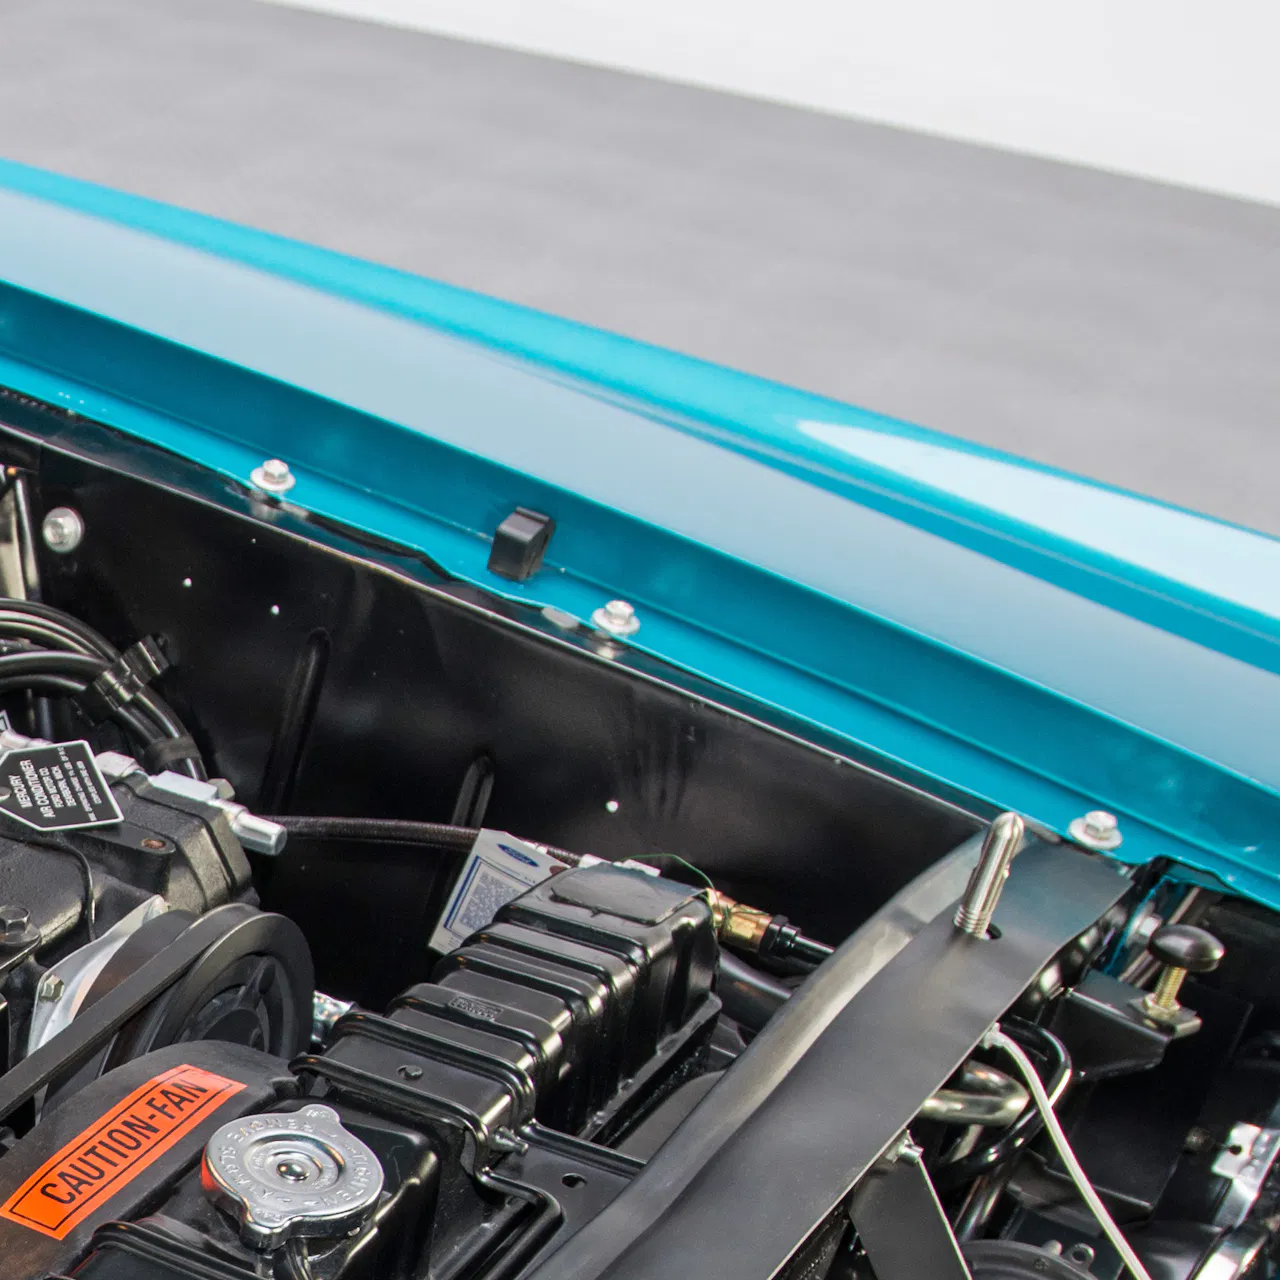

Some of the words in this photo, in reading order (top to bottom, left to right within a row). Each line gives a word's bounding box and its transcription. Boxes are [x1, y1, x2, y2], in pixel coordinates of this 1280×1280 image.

[6, 773, 33, 808] MERCURY
[18, 758, 50, 806] CONDITIONER
[41, 775, 58, 794] MOTOR
[38, 804, 56, 819] AIR
[49, 792, 64, 808] FORD
[40, 1079, 208, 1205] CAUTION-FAN
